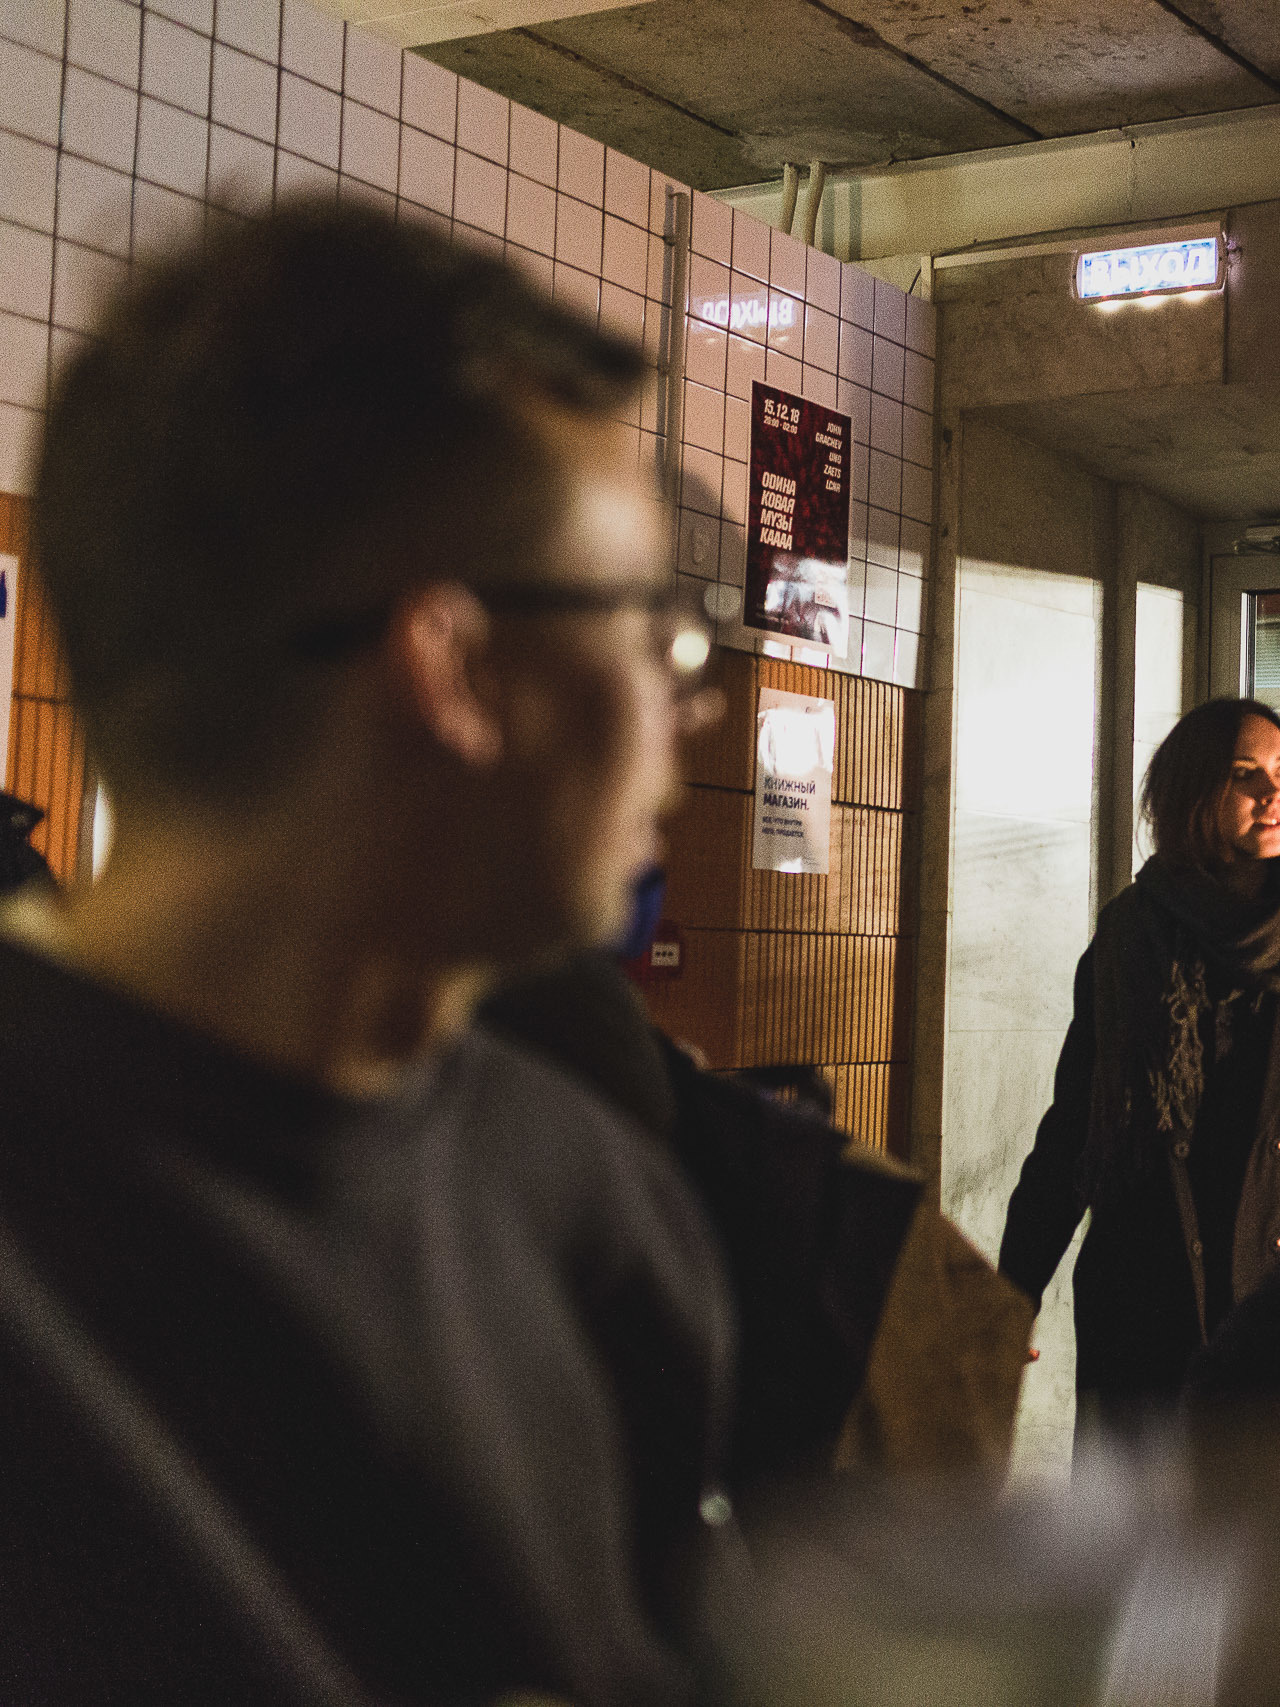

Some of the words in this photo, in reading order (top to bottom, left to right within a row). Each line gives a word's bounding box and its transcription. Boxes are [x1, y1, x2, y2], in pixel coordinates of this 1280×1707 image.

[1089, 248, 1210, 295] ВЫХОД
[764, 399, 800, 424] 15.12.18
[823, 464, 842, 479] ZAETS
[760, 489, 796, 515] КОВАЯ
[760, 508, 794, 533] МУЗЫ
[759, 527, 793, 551] КАААА
